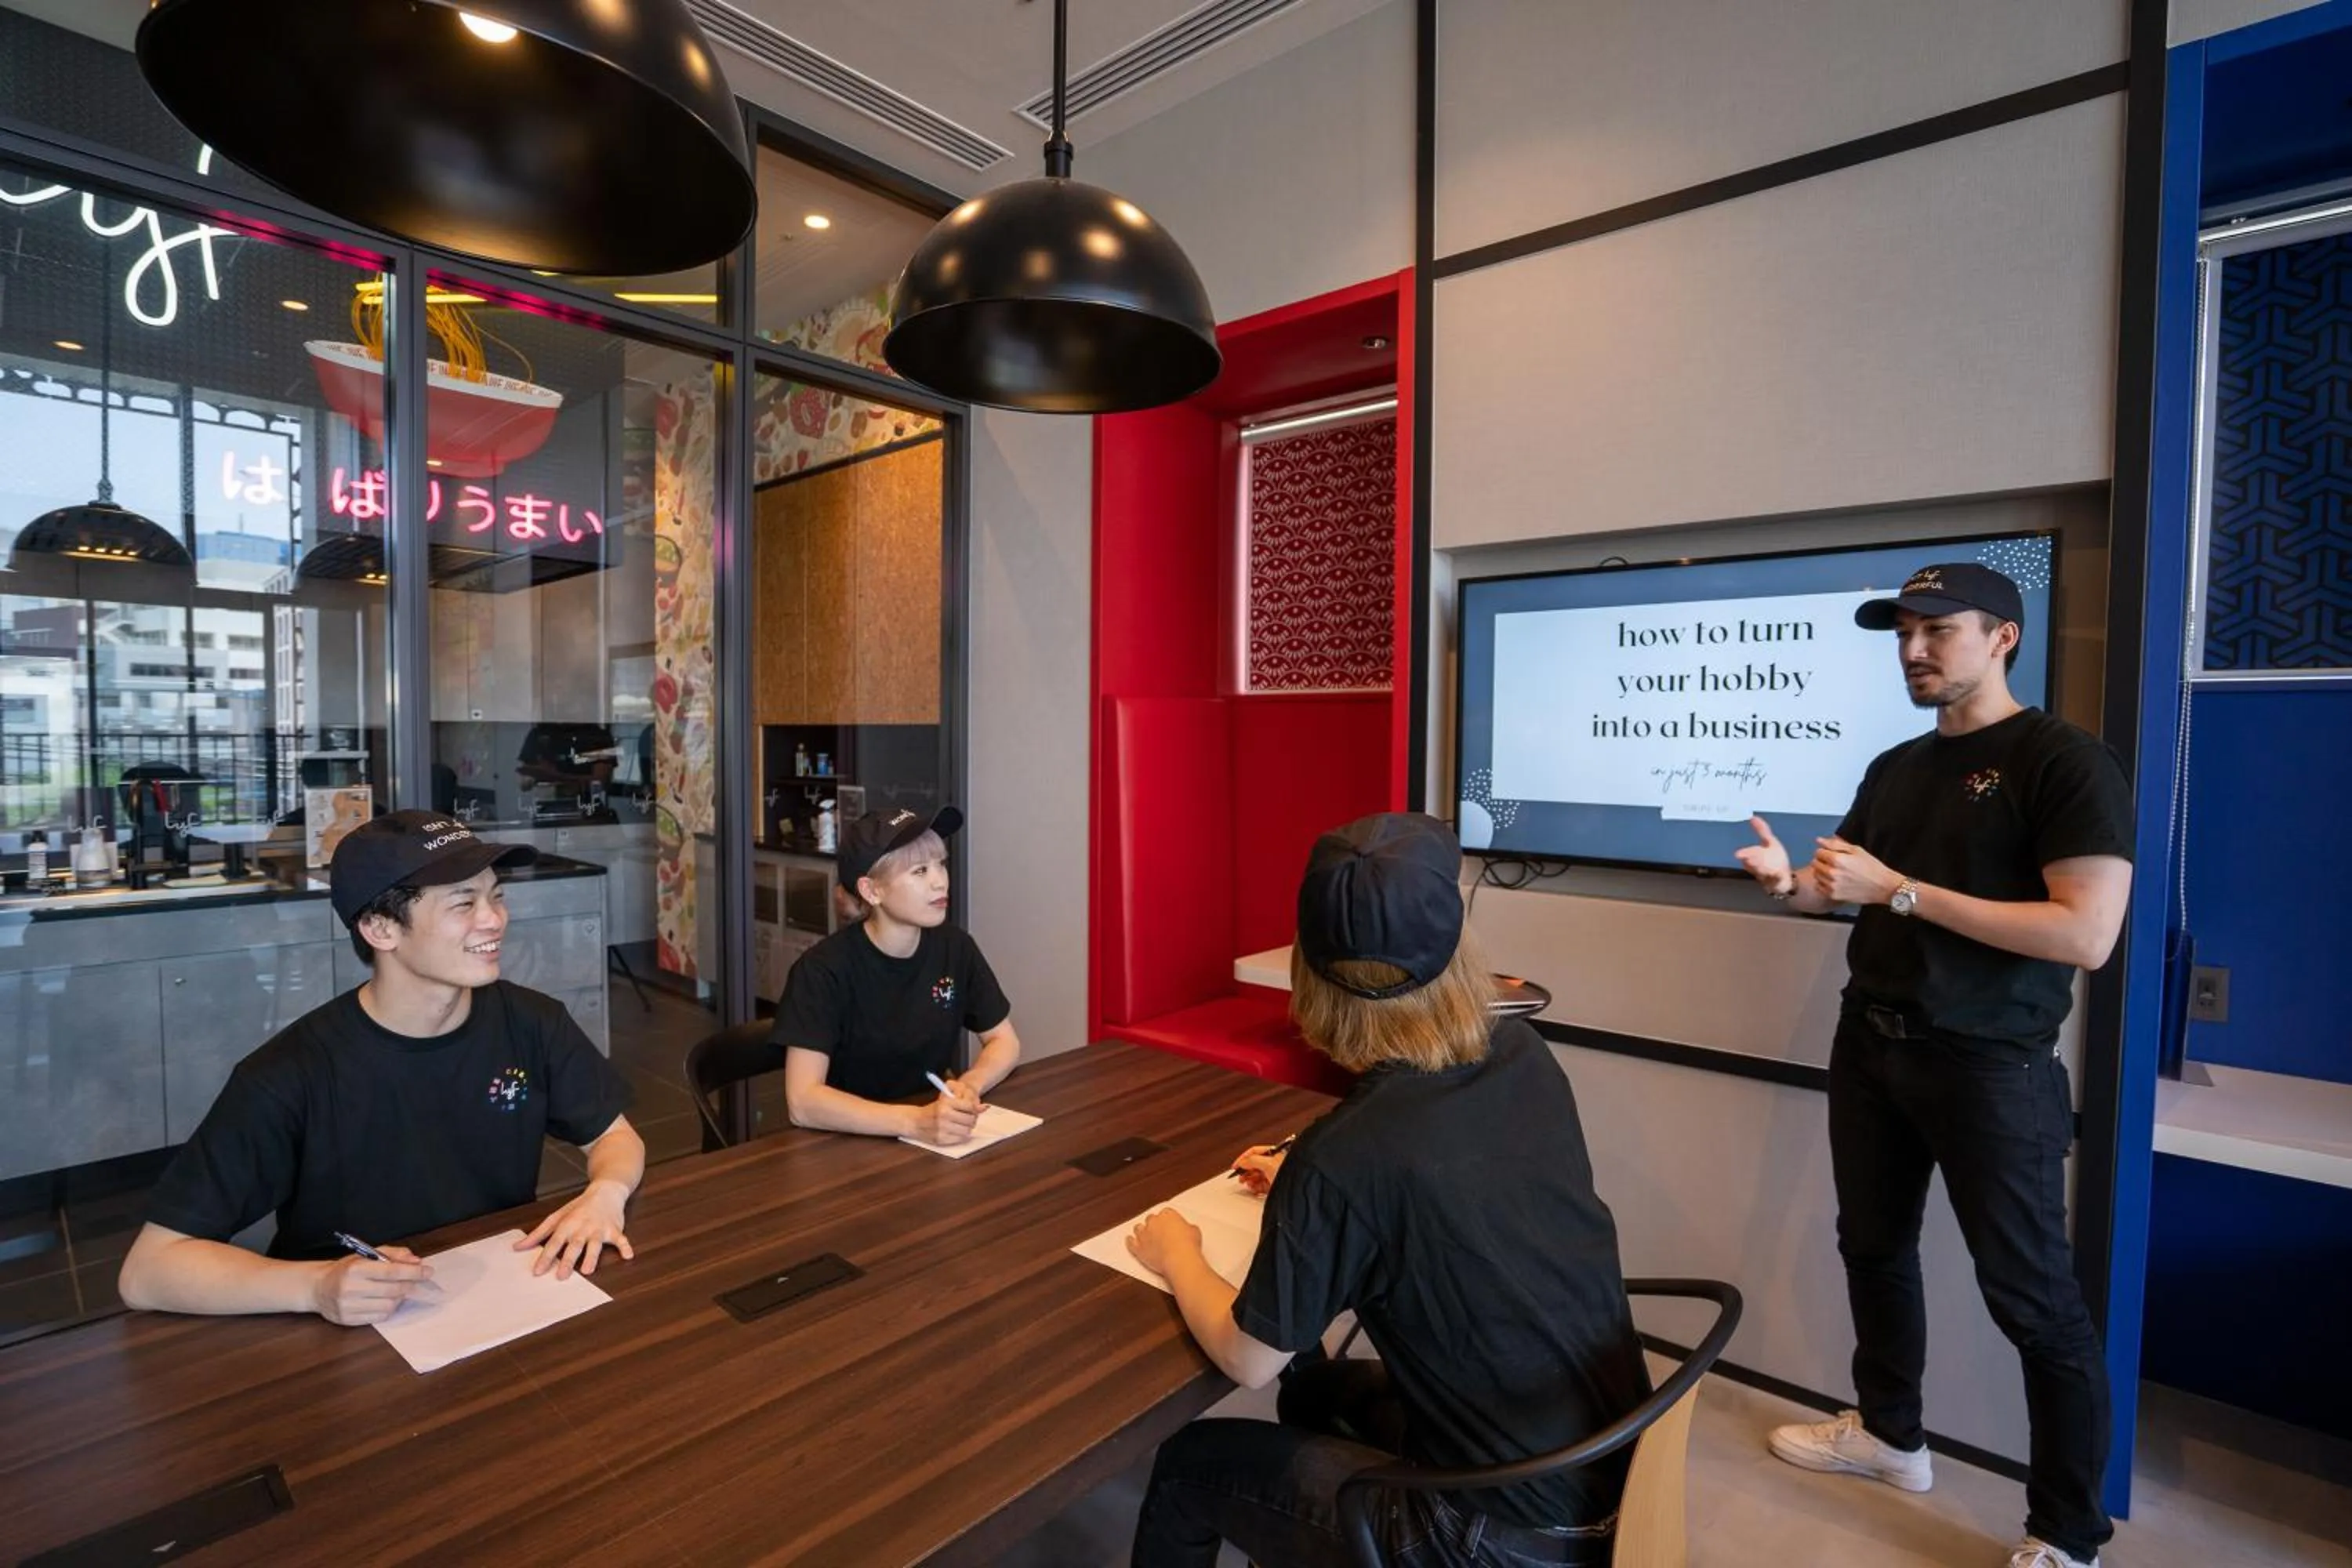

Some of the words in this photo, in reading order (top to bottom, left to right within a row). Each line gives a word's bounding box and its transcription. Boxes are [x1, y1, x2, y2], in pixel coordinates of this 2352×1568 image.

[1618, 622, 1686, 648] how
[1696, 622, 1729, 644] to
[1738, 619, 1814, 643] turn
[1618, 673, 1690, 699] your
[1700, 662, 1812, 697] hobby
[1593, 714, 1651, 738] into
[1660, 720, 1679, 738] a
[1689, 711, 1842, 739] business
[1661, 757, 1702, 794] just
[1714, 757, 1767, 792] months
